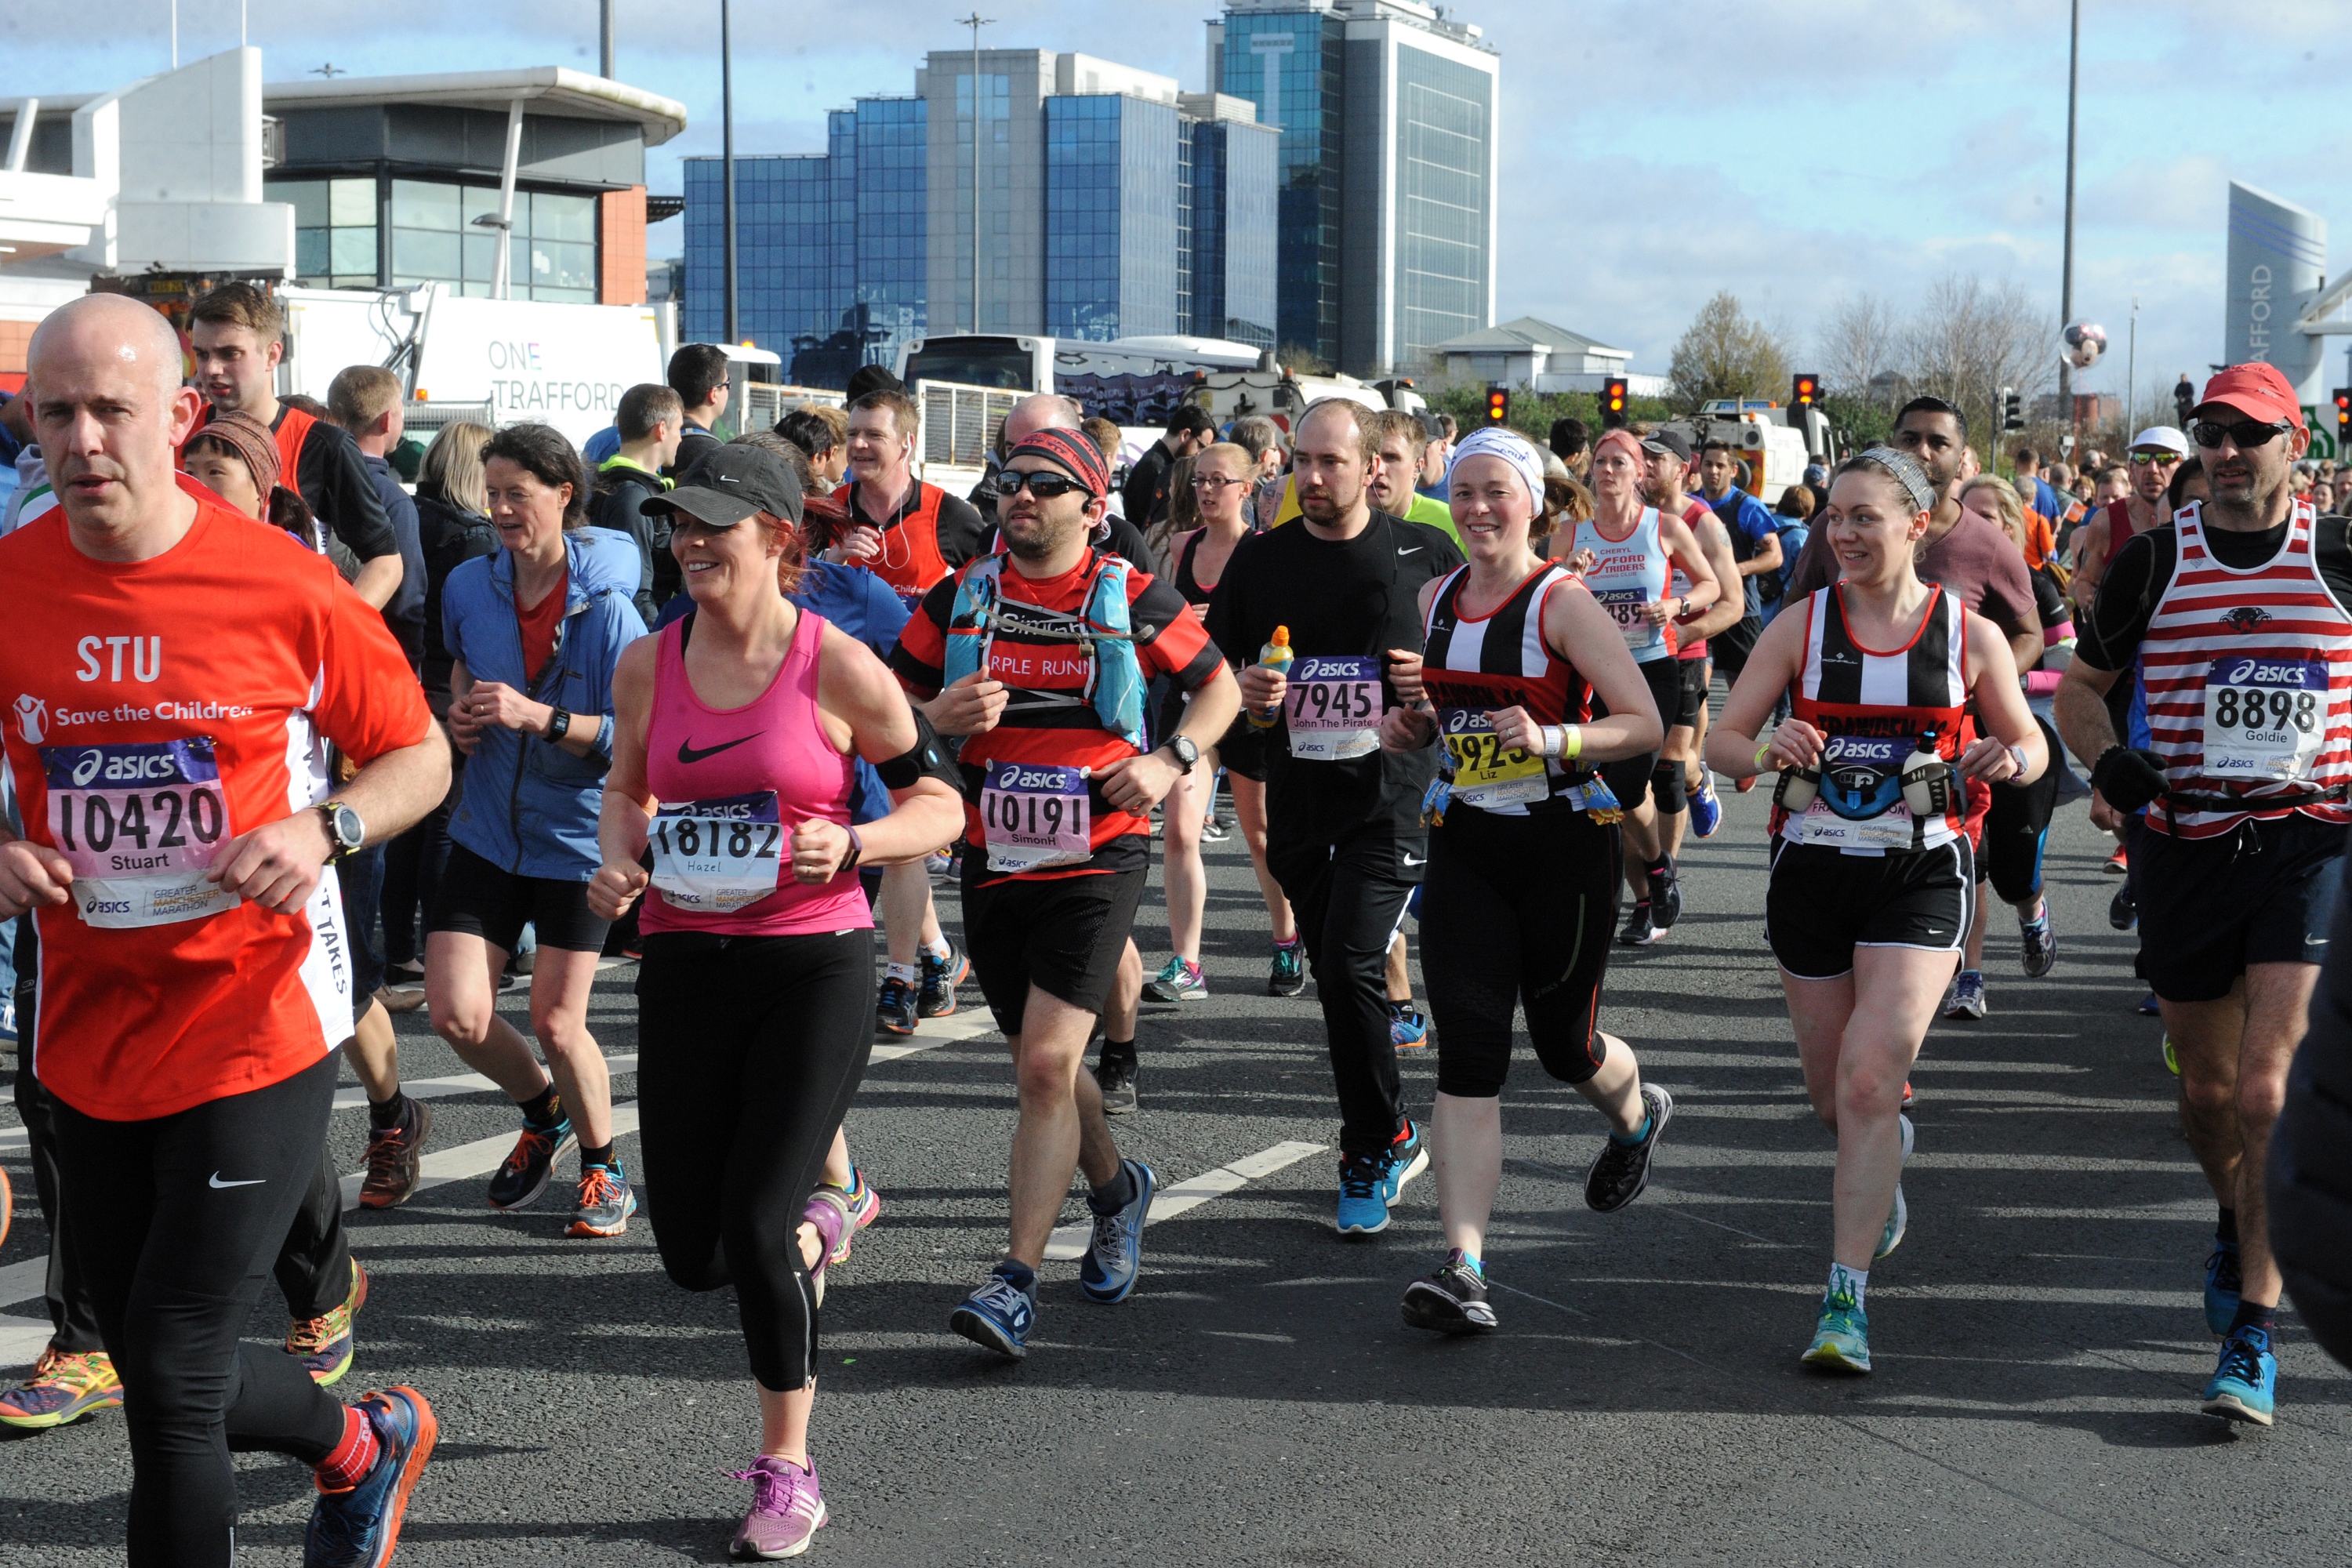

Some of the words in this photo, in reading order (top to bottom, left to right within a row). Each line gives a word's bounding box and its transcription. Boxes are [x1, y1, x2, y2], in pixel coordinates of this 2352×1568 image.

[2249, 264, 2272, 363] AFFORD
[488, 340, 542, 370] ONE
[492, 380, 625, 411] TRAFFORD
[1606, 604, 1642, 624] 489
[76, 635, 161, 683] STU
[990, 655, 1032, 675] RPLE
[1292, 683, 1372, 718] 7945
[2216, 688, 2316, 733] 8898
[56, 708, 110, 726] Save
[114, 703, 152, 720] the
[1294, 719, 1317, 728] John
[1320, 719, 1339, 728] The
[1343, 719, 1373, 728] Pirate
[2245, 730, 2288, 743] Goldie
[1480, 771, 1497, 780] Liz
[1497, 786, 1537, 796] MANCHESTER
[60, 788, 223, 853] 10420
[988, 793, 1080, 835] 10191
[657, 818, 779, 858] 18182
[1011, 833, 1057, 846] SimonH
[111, 853, 170, 870] Stuart
[688, 861, 721, 873] Hazel
[153, 884, 198, 899] GREATER
[153, 888, 220, 907] MANCHESTER
[152, 899, 209, 916] MARATHON
[317, 914, 347, 995] TAKES
